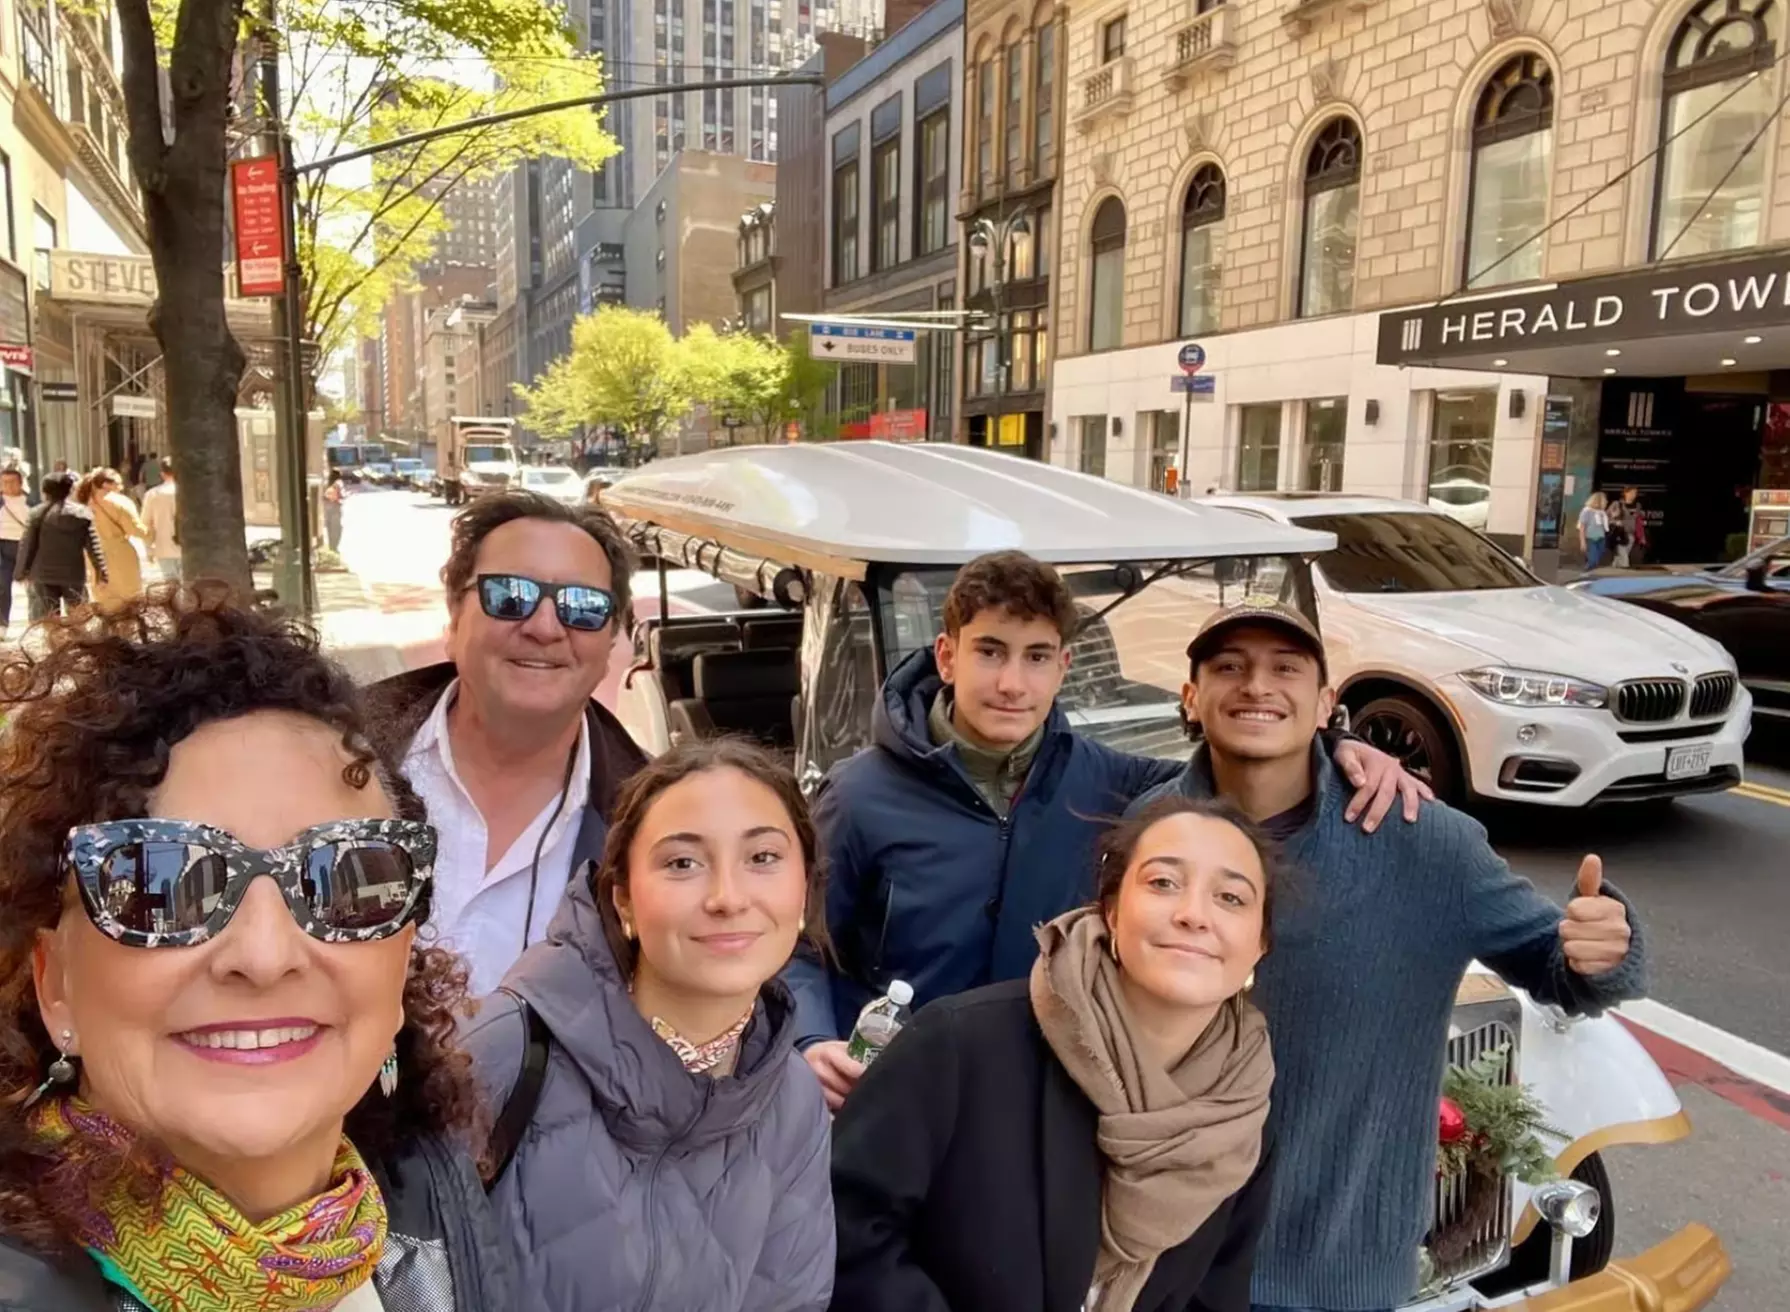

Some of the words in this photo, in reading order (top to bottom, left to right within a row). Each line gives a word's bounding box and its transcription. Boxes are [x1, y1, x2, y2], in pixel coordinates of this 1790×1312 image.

[67, 258, 157, 297] STEVE
[1441, 295, 1623, 344] HERALD
[847, 343, 879, 355] BUSES
[881, 345, 905, 356] ONLY
